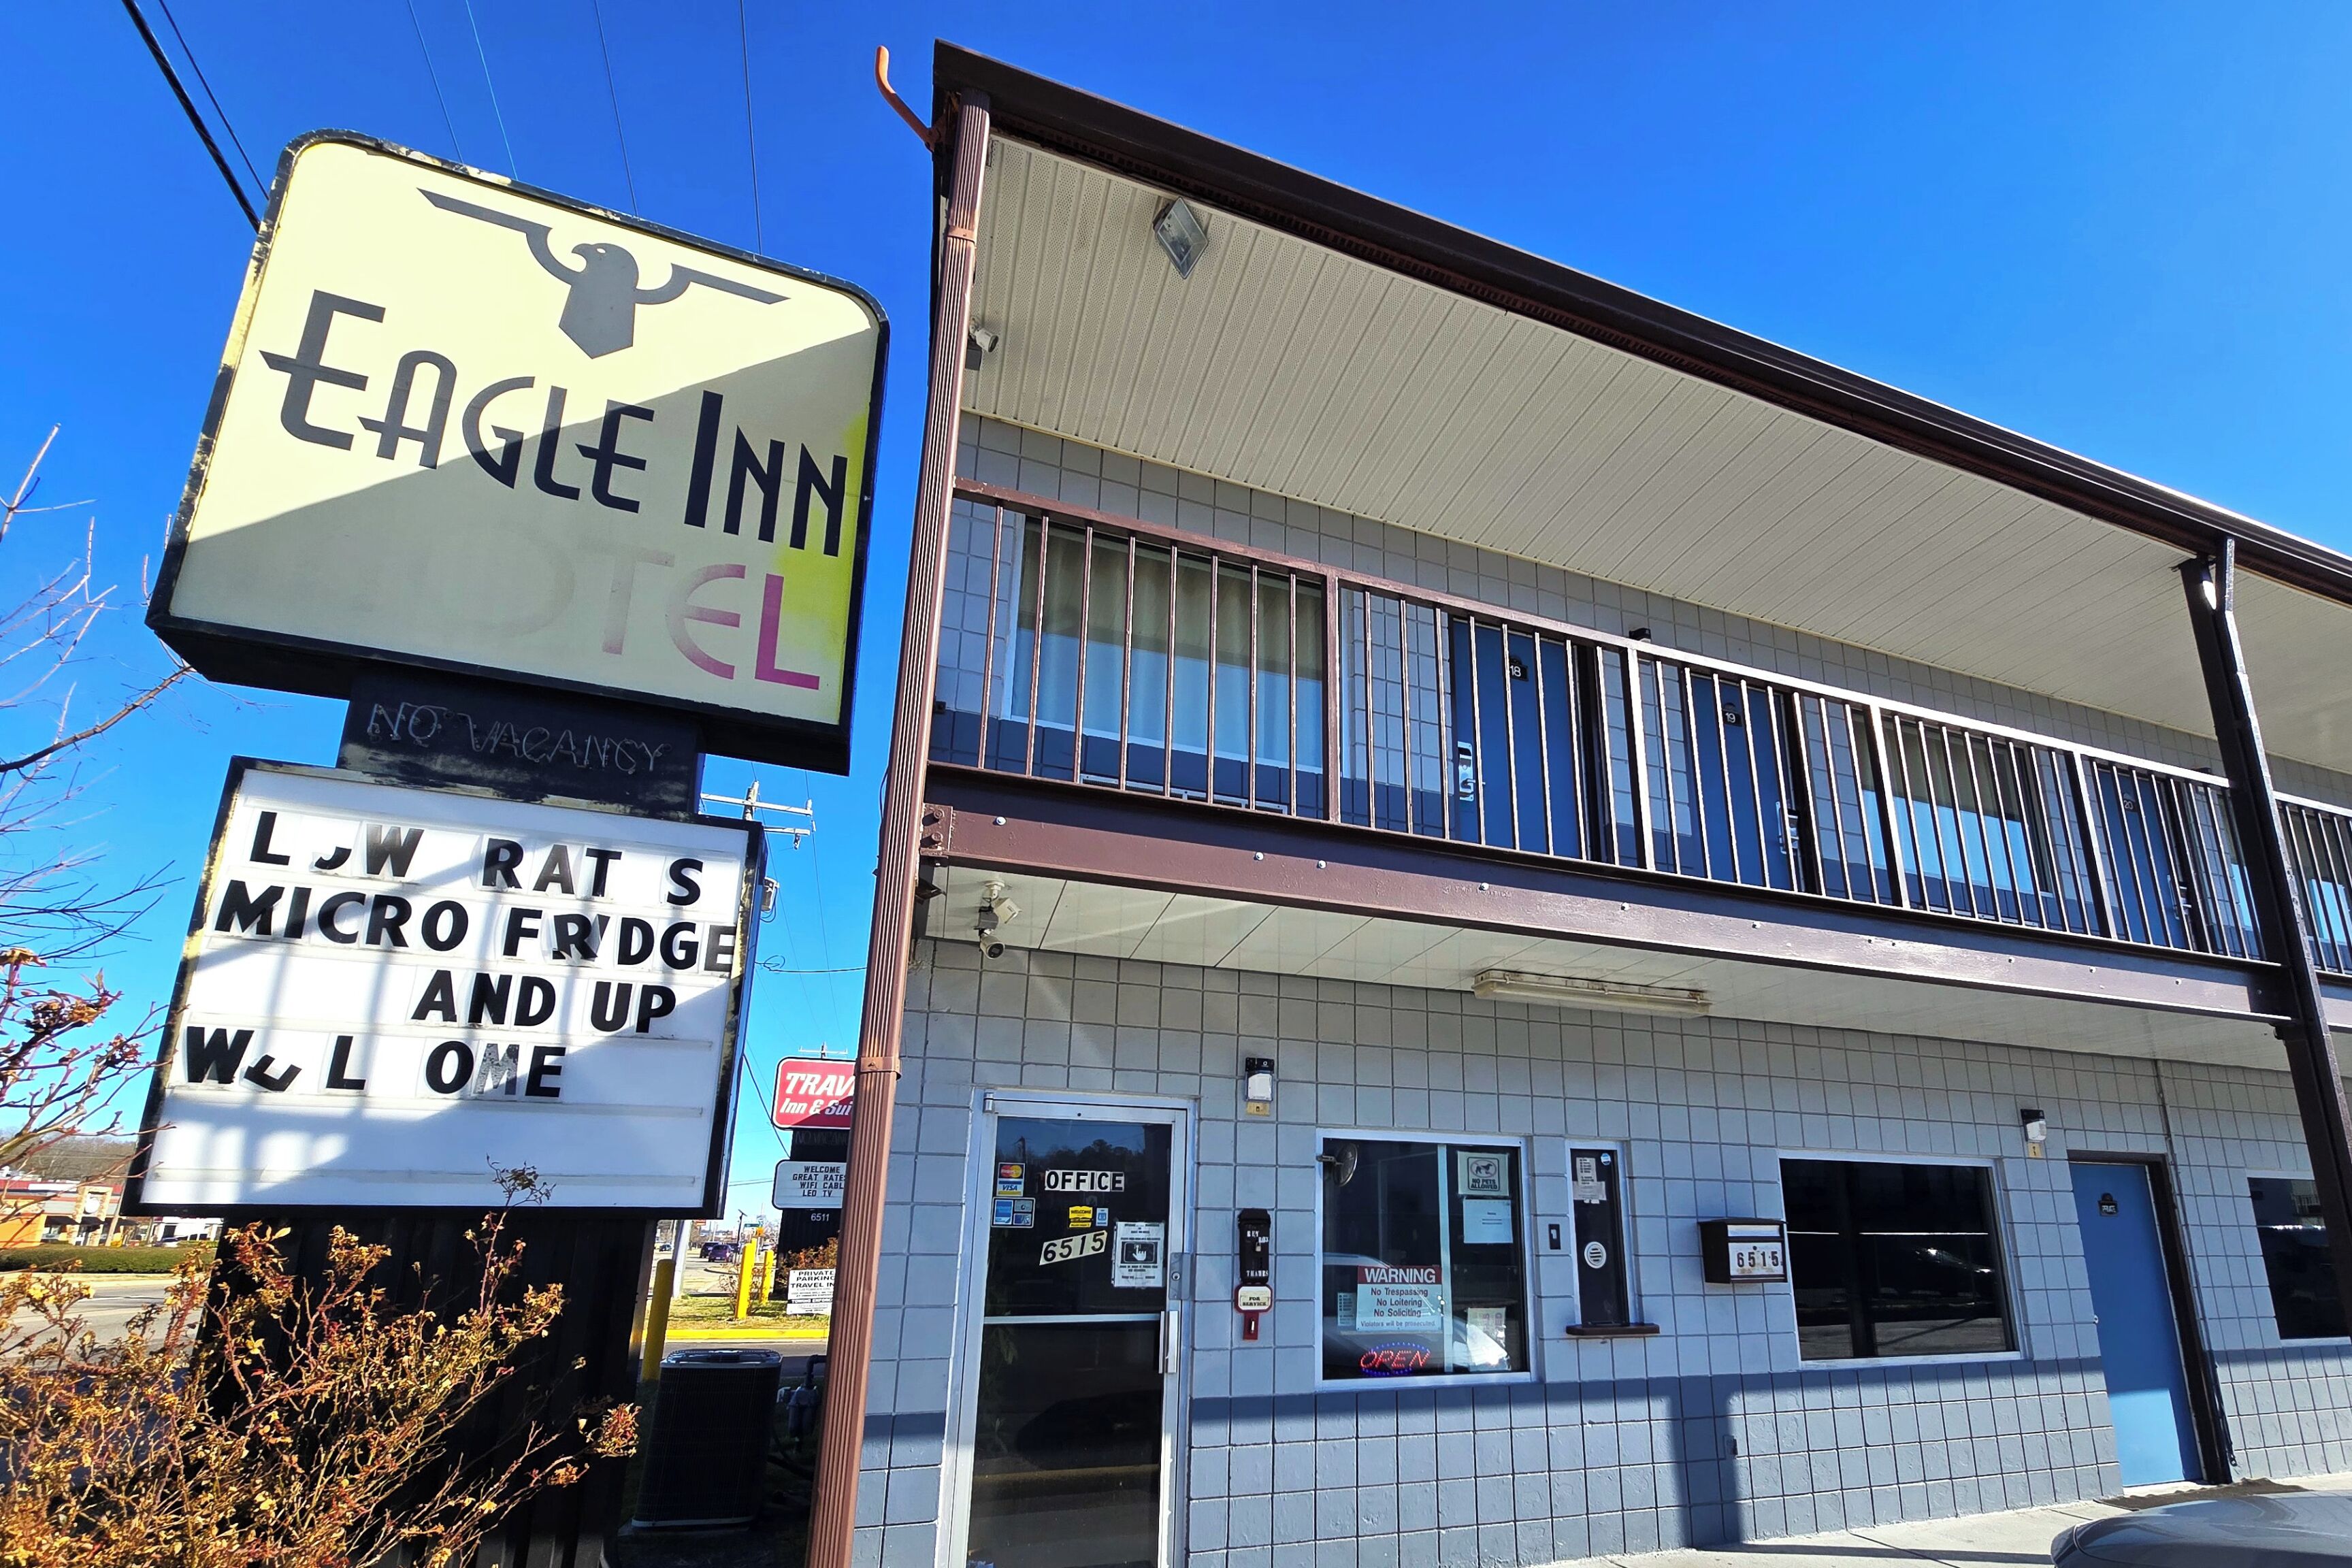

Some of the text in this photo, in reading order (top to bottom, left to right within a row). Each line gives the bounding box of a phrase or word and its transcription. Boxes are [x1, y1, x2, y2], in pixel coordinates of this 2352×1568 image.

[259, 289, 848, 557] EAGLE INN
[1510, 665, 1521, 677] 18
[1725, 712, 1735, 723] 19
[368, 702, 668, 774] NO VACANCY
[2123, 800, 2134, 810] 20
[214, 879, 468, 951] MICRO
[411, 970, 676, 1033] AND UP
[785, 1073, 855, 1096] TRAV
[779, 1098, 808, 1114] Inn
[809, 1099, 824, 1115] &
[1046, 1171, 1123, 1190] OFFICE
[811, 1213, 830, 1222] 6511
[1043, 1232, 1105, 1262] 6515
[1737, 1251, 1779, 1267] 6515
[1365, 1268, 1436, 1284] WARNING
[1371, 1287, 1428, 1297] No Trespassing
[1377, 1298, 1422, 1307] No Loitering
[1374, 1308, 1422, 1318] No Soliciting
[1360, 1350, 1431, 1368] OPEN
